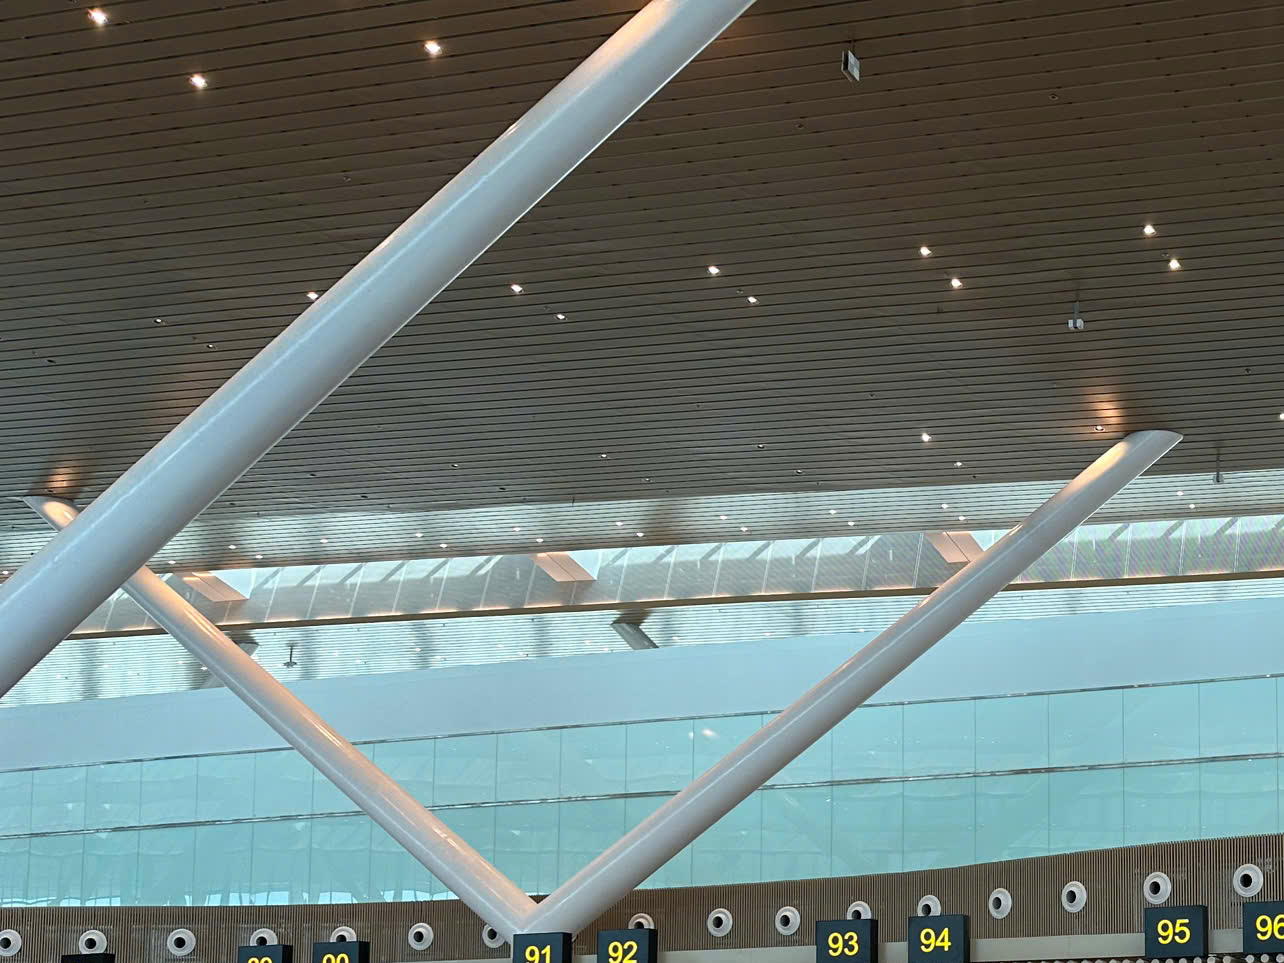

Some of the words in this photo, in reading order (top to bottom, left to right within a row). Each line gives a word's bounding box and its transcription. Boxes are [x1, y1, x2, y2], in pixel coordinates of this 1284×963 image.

[828, 931, 859, 957] 93
[919, 927, 952, 953] 94
[1157, 919, 1191, 945] 95
